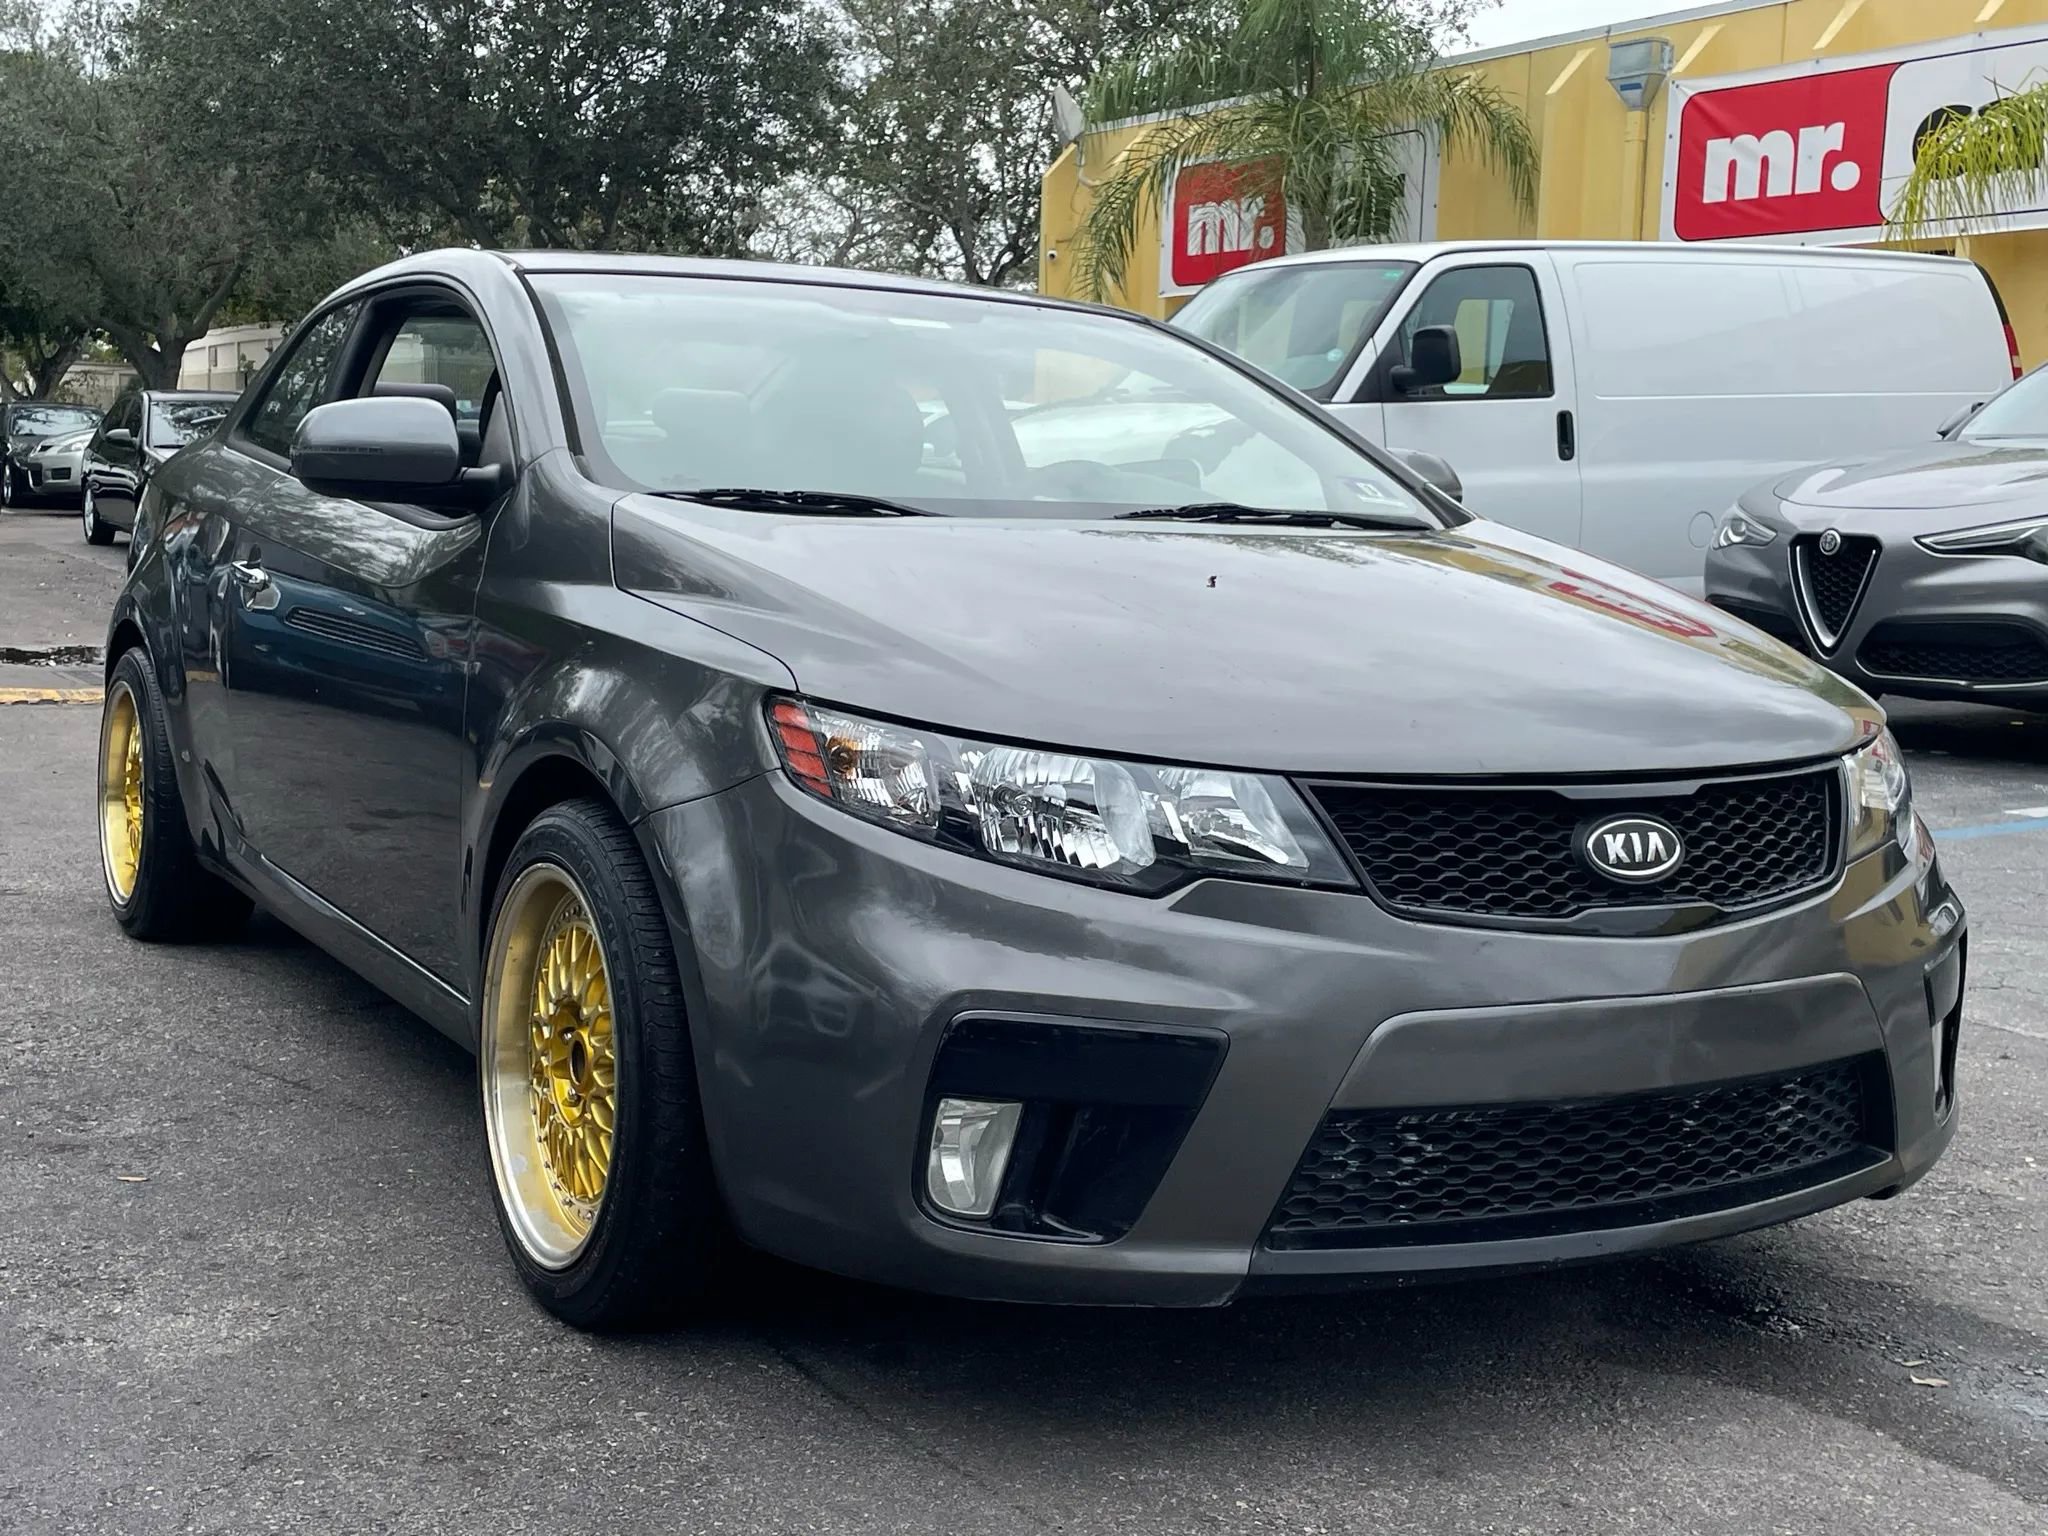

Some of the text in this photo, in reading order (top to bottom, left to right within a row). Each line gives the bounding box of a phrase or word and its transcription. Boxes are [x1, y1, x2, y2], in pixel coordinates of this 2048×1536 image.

[1702, 121, 1861, 204] mr.
[1187, 195, 1275, 257] mr.
[1603, 831, 1669, 864] KIA
